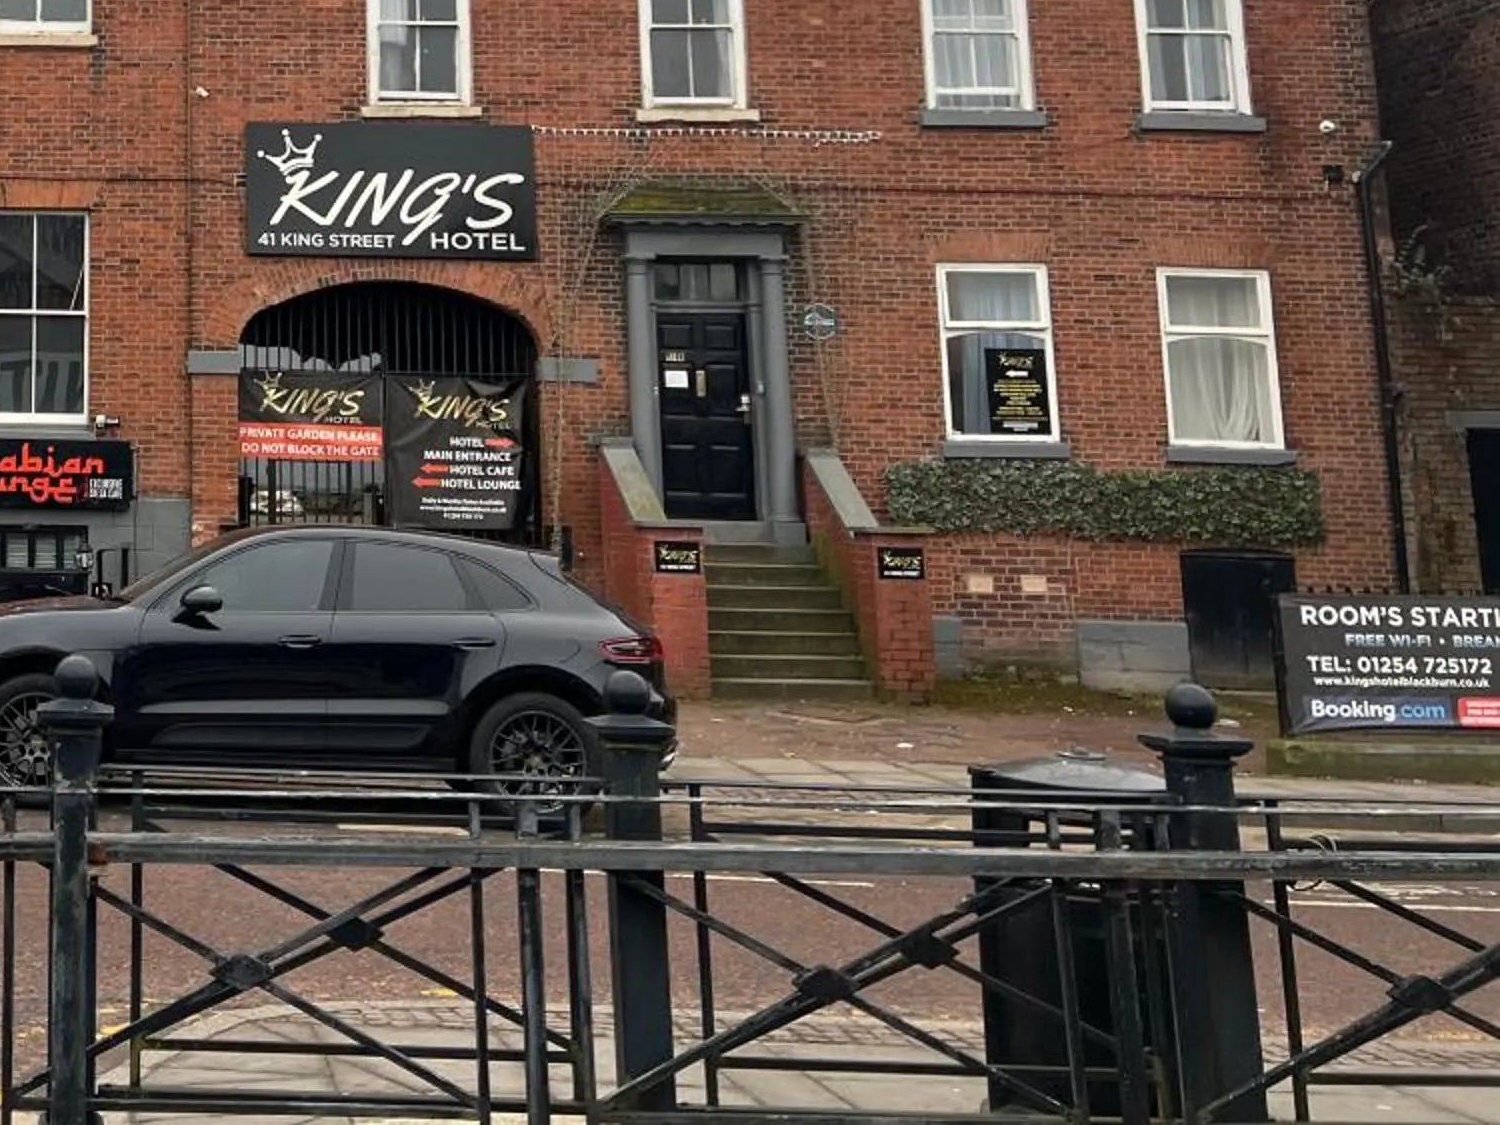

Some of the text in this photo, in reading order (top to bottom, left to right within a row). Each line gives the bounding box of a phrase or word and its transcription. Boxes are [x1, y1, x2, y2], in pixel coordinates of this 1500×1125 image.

[269, 168, 525, 246] KING'S
[258, 232, 396, 249] 41 KING STREET
[431, 231, 526, 252] HOTEL
[260, 388, 365, 424] KING'S
[413, 394, 510, 428] KING'S
[239, 426, 285, 439] PRIVATE
[241, 442, 380, 456] DO NOT BLOCK THE GATE
[449, 436, 485, 447] HOTEL
[423, 450, 511, 462] MAIN ENTRANCE
[449, 465, 514, 475] HOTEL CAFE
[441, 478, 521, 490] HOTEL LOUNGE
[1300, 605, 1403, 626] ROOM'S
[1345, 634, 1385, 647] FREE
[1389, 635, 1431, 647] WI-FI
[1306, 654, 1492, 674] TEL: 01254 725172
